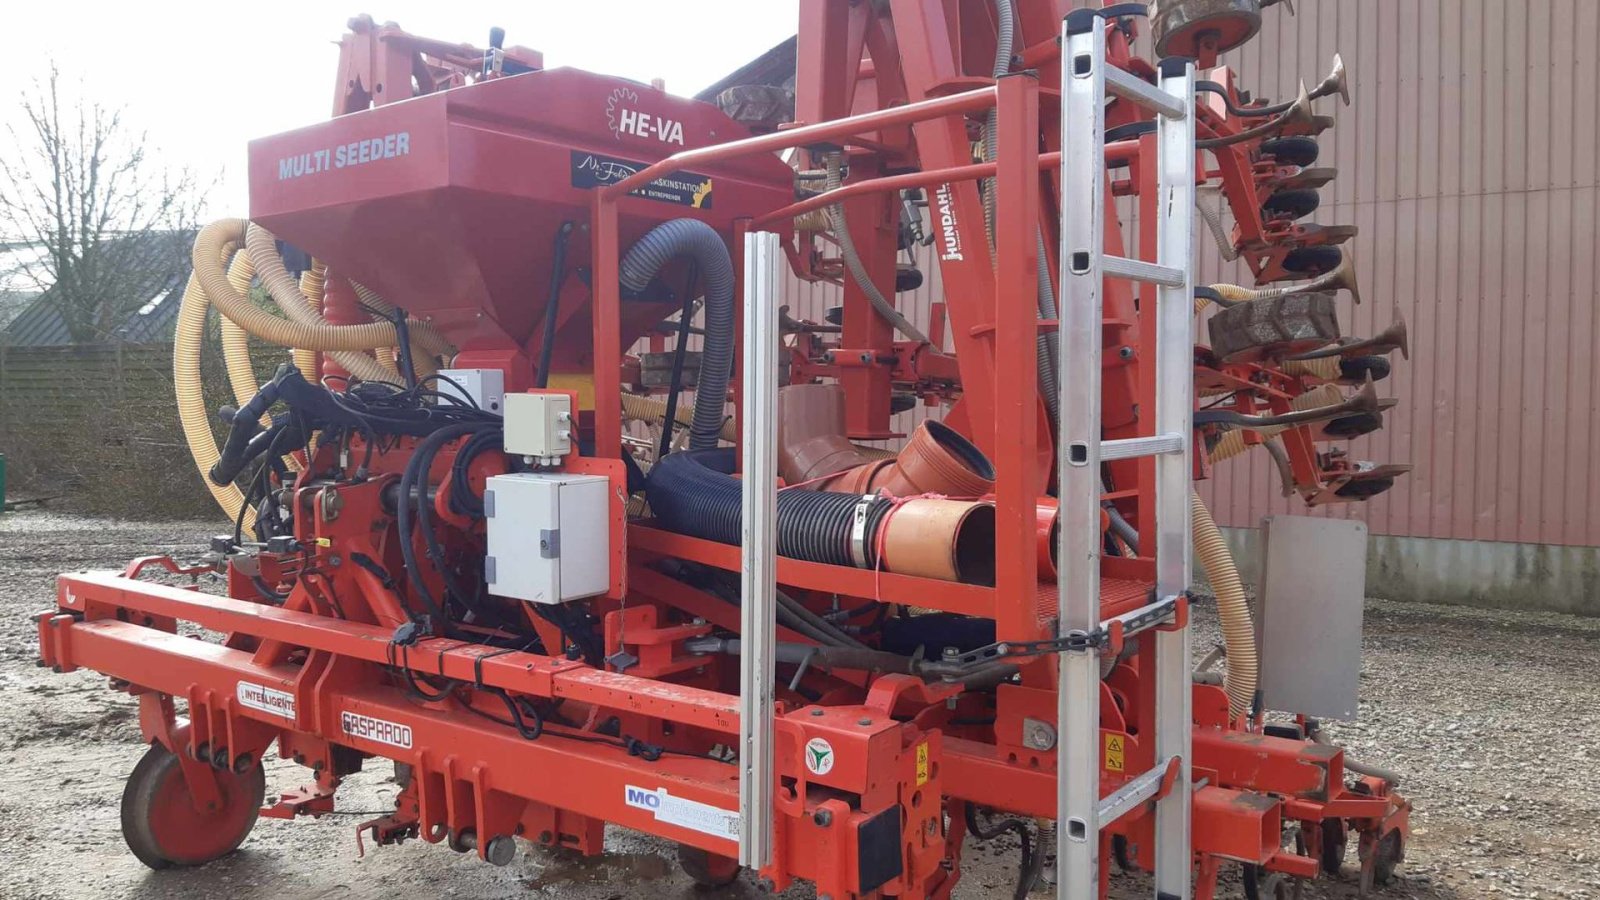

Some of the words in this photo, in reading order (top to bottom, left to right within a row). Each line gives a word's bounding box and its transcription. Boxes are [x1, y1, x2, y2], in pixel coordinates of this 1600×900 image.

[619, 109, 684, 146] HE-VA
[279, 149, 330, 180] MULTI
[334, 132, 410, 168] SEEDER
[343, 713, 411, 746] GASPARDO
